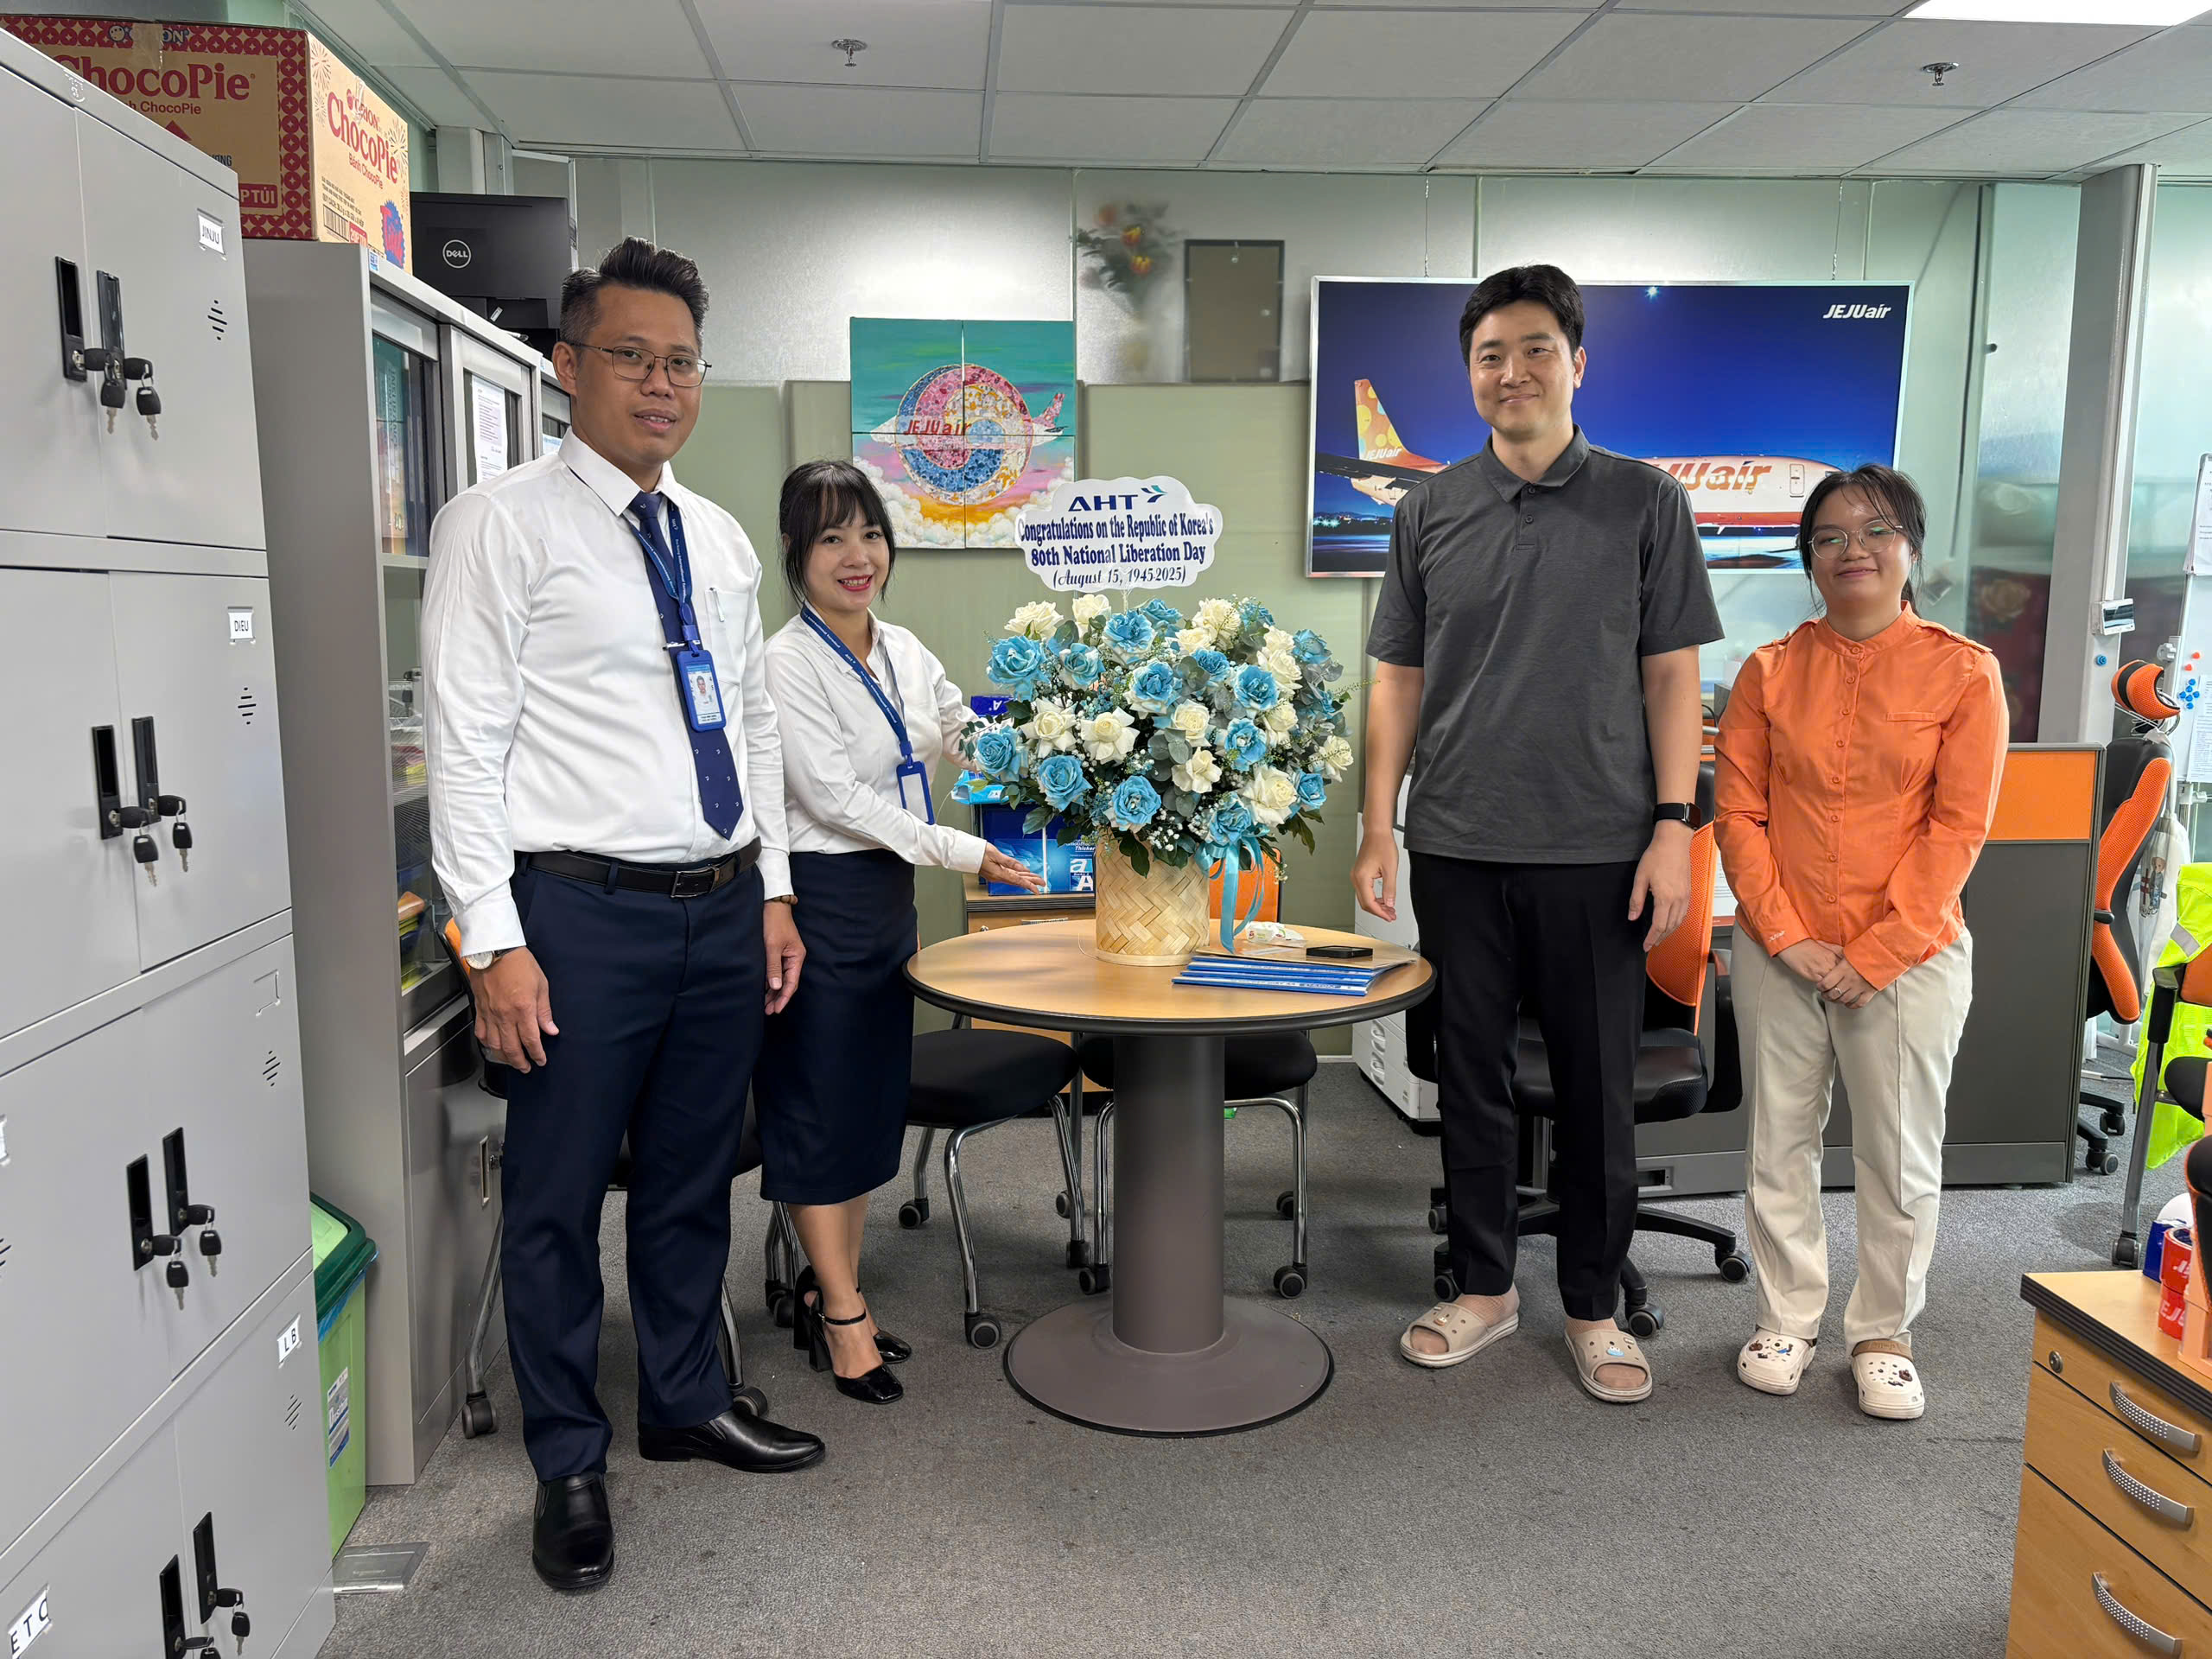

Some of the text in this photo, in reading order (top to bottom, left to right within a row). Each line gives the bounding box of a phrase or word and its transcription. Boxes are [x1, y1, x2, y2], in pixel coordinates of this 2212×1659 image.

[140, 101, 201, 114] ChocoPie
[327, 92, 398, 184] ChocoPie
[1822, 303, 1892, 319] JEJUair
[903, 419, 972, 435] JEJUair
[1068, 494, 1138, 512] AHT
[1018, 512, 1214, 546] Congratulations on the Republic of Korea's
[1031, 541, 1205, 566] 80th National Liberation Day
[1052, 569, 1103, 588] (August
[1108, 569, 1123, 586] 15,
